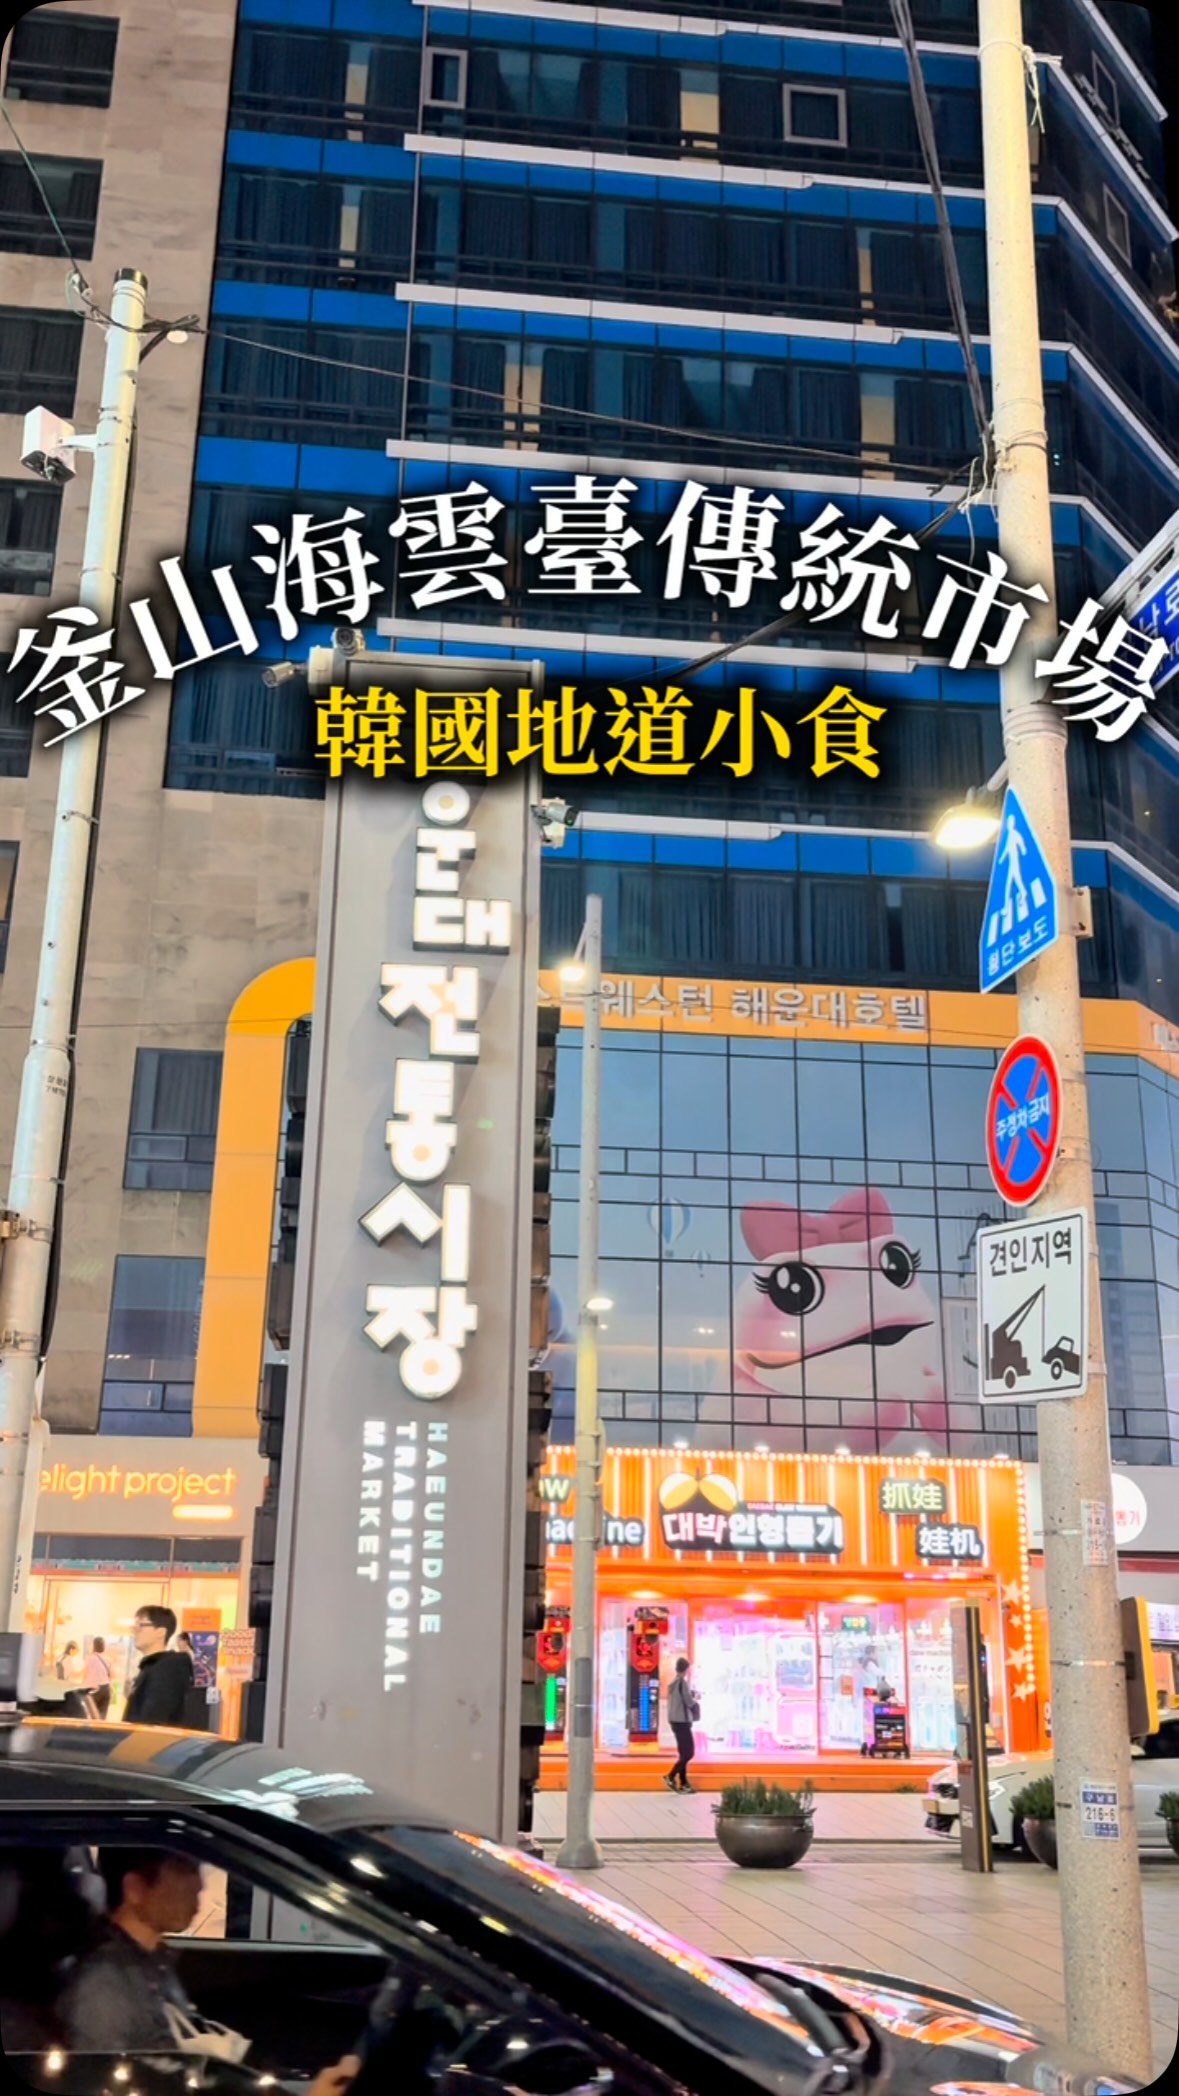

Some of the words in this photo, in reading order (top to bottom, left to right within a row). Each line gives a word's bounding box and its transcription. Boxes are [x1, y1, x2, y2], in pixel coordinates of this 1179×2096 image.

[731, 989, 926, 1032] 해운대호텔
[358, 780, 511, 1398] 운대전통시장
[996, 1092, 1050, 1141] 주정차금지
[989, 1227, 1073, 1278] 견인지역
[39, 1463, 120, 1500] elight
[124, 1466, 237, 1502] project
[357, 1420, 386, 1582] MARKET
[882, 1481, 944, 1510] 抓娃
[419, 1422, 448, 1633] HAEUNDAE
[918, 1526, 982, 1556] 娃机
[384, 1421, 417, 1691] TRADITIONAL
